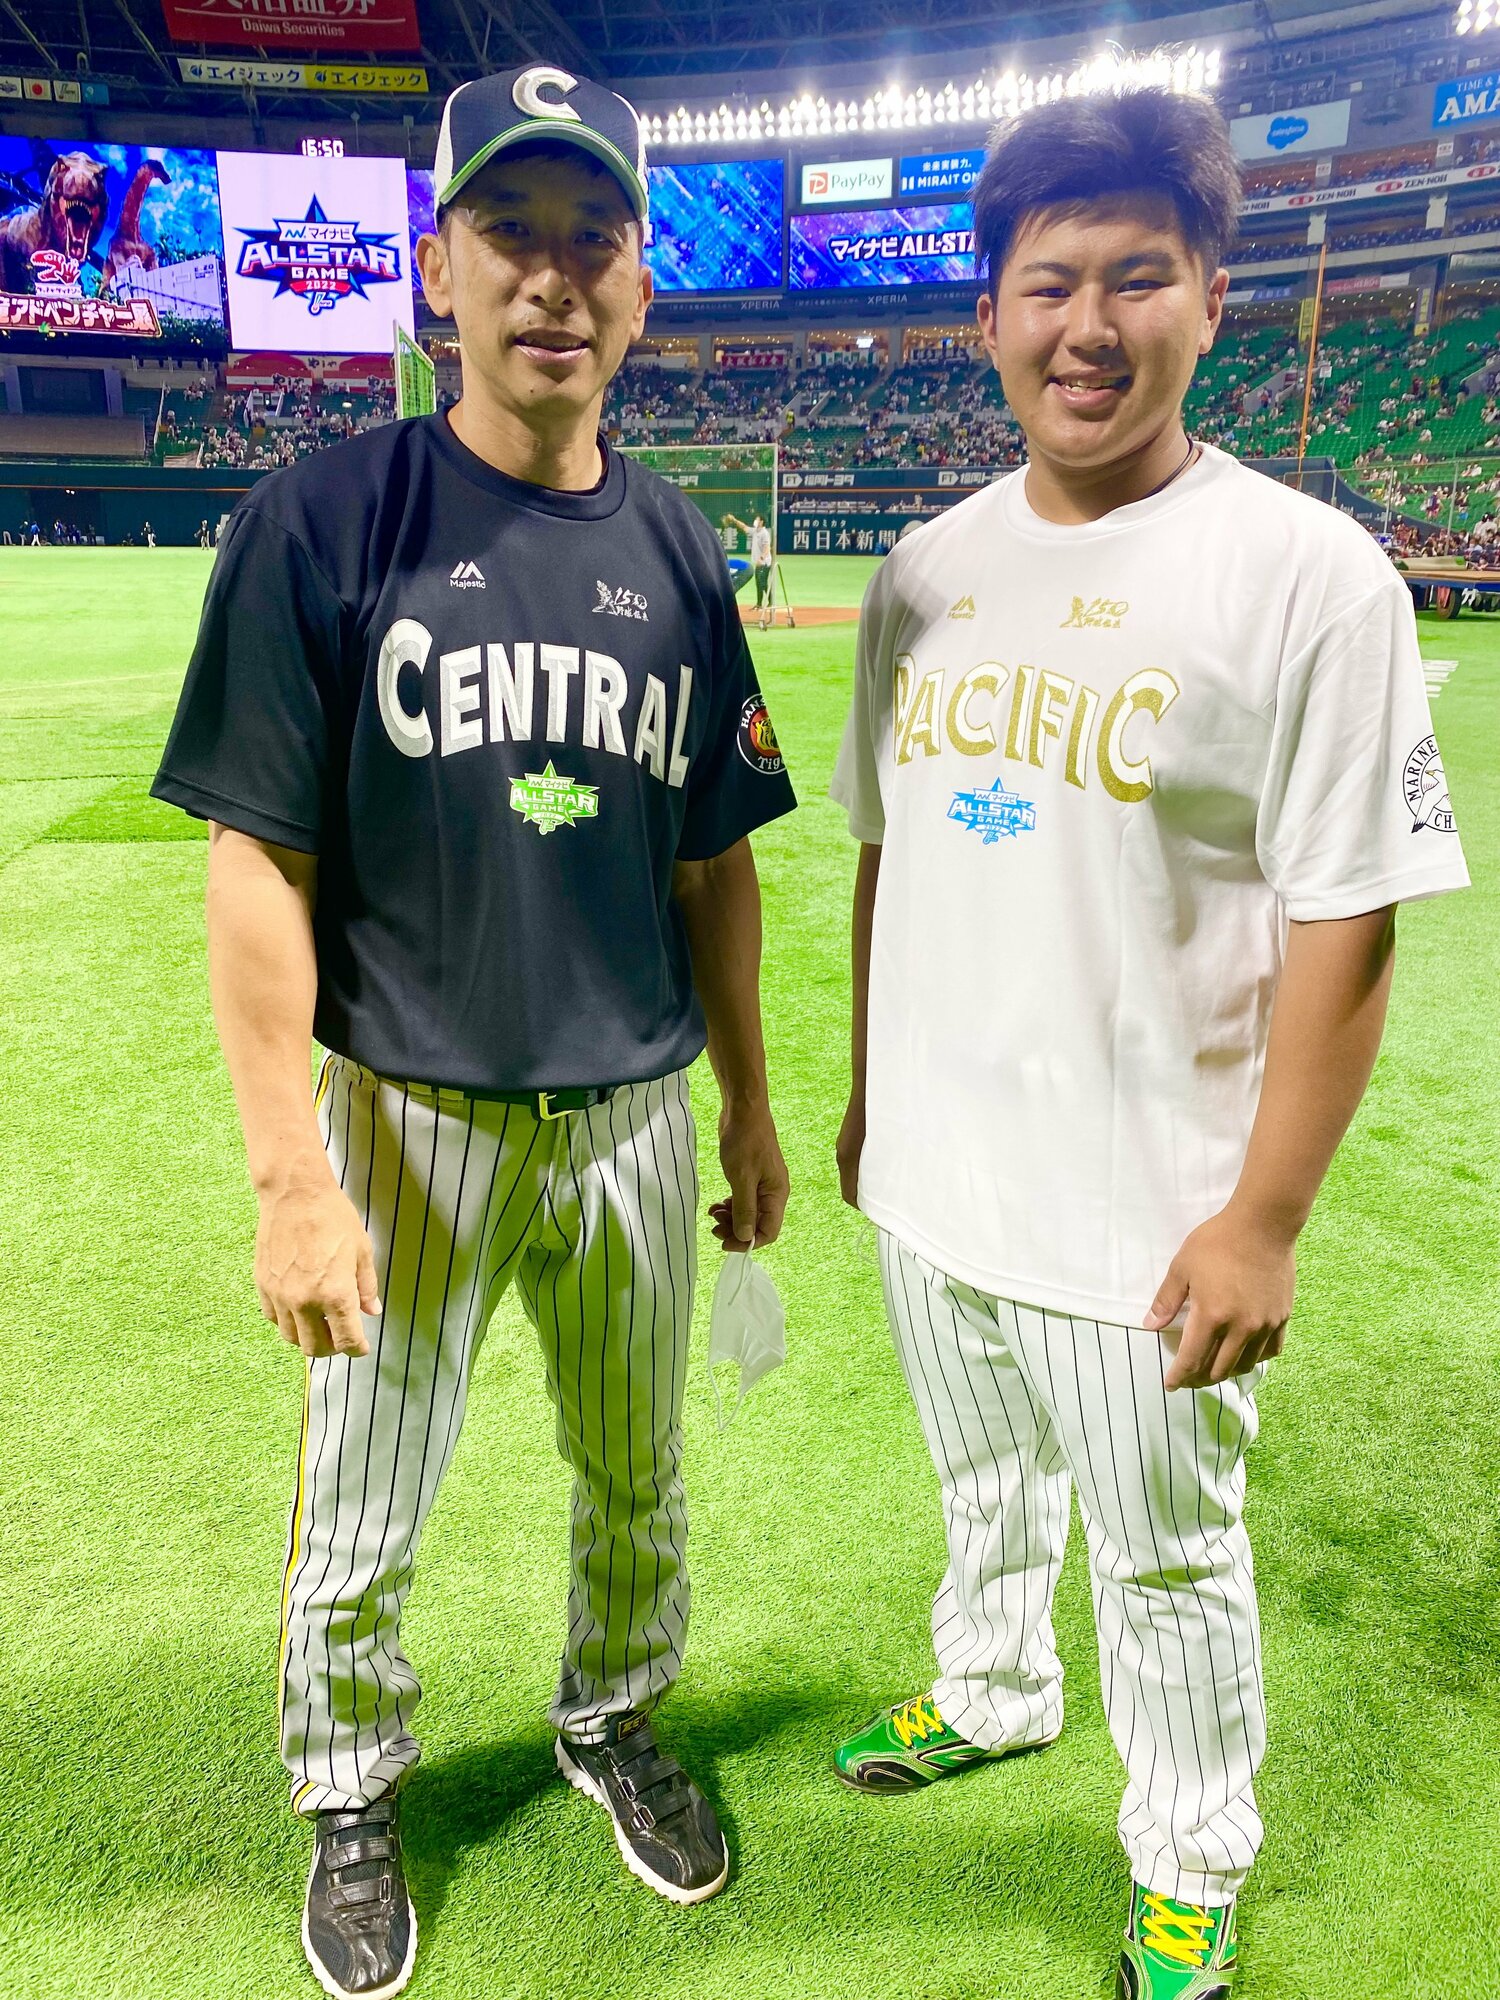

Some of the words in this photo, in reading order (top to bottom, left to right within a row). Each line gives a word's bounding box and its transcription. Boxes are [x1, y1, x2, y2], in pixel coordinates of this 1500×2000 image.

[241, 17, 281, 34] Daiwa
[282, 22, 345, 37] Securities
[207, 65, 300, 84] エイジェック
[331, 71, 421, 87] エイジェック
[1456, 79, 1483, 93] TIME
[512, 67, 582, 121] C
[302, 139, 344, 158] 16:50
[832, 172, 885, 191] PayPay
[918, 173, 960, 188] MIRAIT
[308, 227, 350, 241] マイナビ
[831, 235, 898, 261] マイナビ
[291, 267, 349, 280] GAME
[306, 280, 337, 290] 2022
[741, 300, 780, 311] XPERIA
[867, 293, 908, 305] XPERIA
[960, 471, 1011, 485] 福岡トヨ
[450, 579, 486, 590] Majestic
[377, 618, 694, 788] CENTRAL
[893, 653, 1181, 804] PACIFIC
[758, 756, 784, 770] Tig
[1406, 740, 1438, 802] MARINE
[545, 780, 568, 790] マイナビ
[992, 793, 1016, 804] マイナビ
[532, 803, 565, 813] GAME
[977, 815, 1011, 826] GAME
